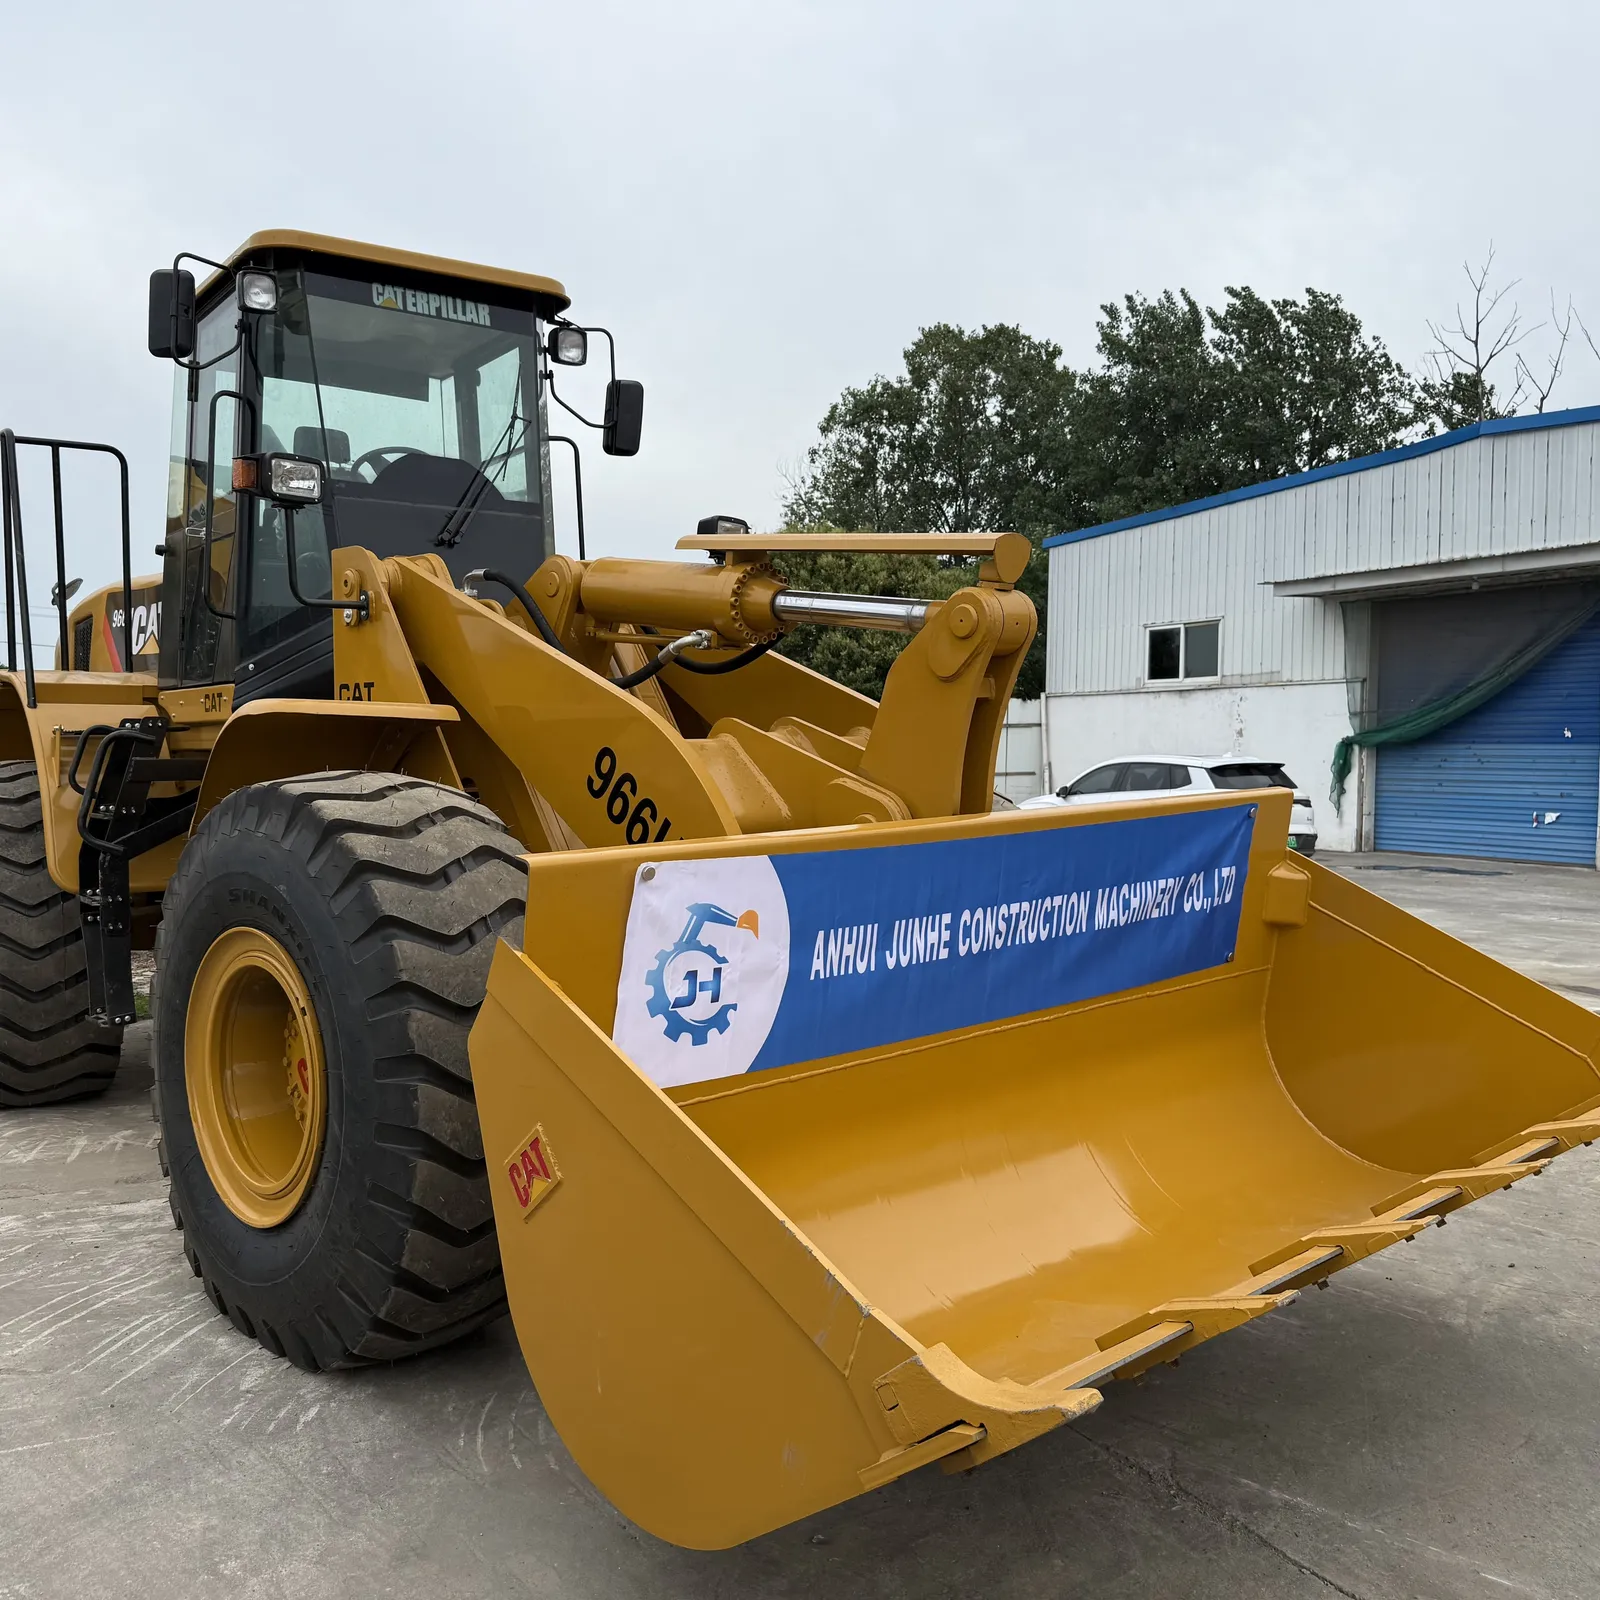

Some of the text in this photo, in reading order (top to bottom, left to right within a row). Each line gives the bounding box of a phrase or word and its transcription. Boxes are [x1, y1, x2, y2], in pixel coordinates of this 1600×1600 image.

[372, 282, 491, 327] CATERPILLAR
[204, 692, 222, 712] CAT
[338, 681, 375, 702] CAT
[810, 923, 879, 981] ANHUI
[885, 912, 952, 970] JUNHE
[958, 890, 1091, 957] CONSTRUCTION
[1094, 876, 1185, 931] MACHINERY
[508, 1136, 552, 1209] CAT
